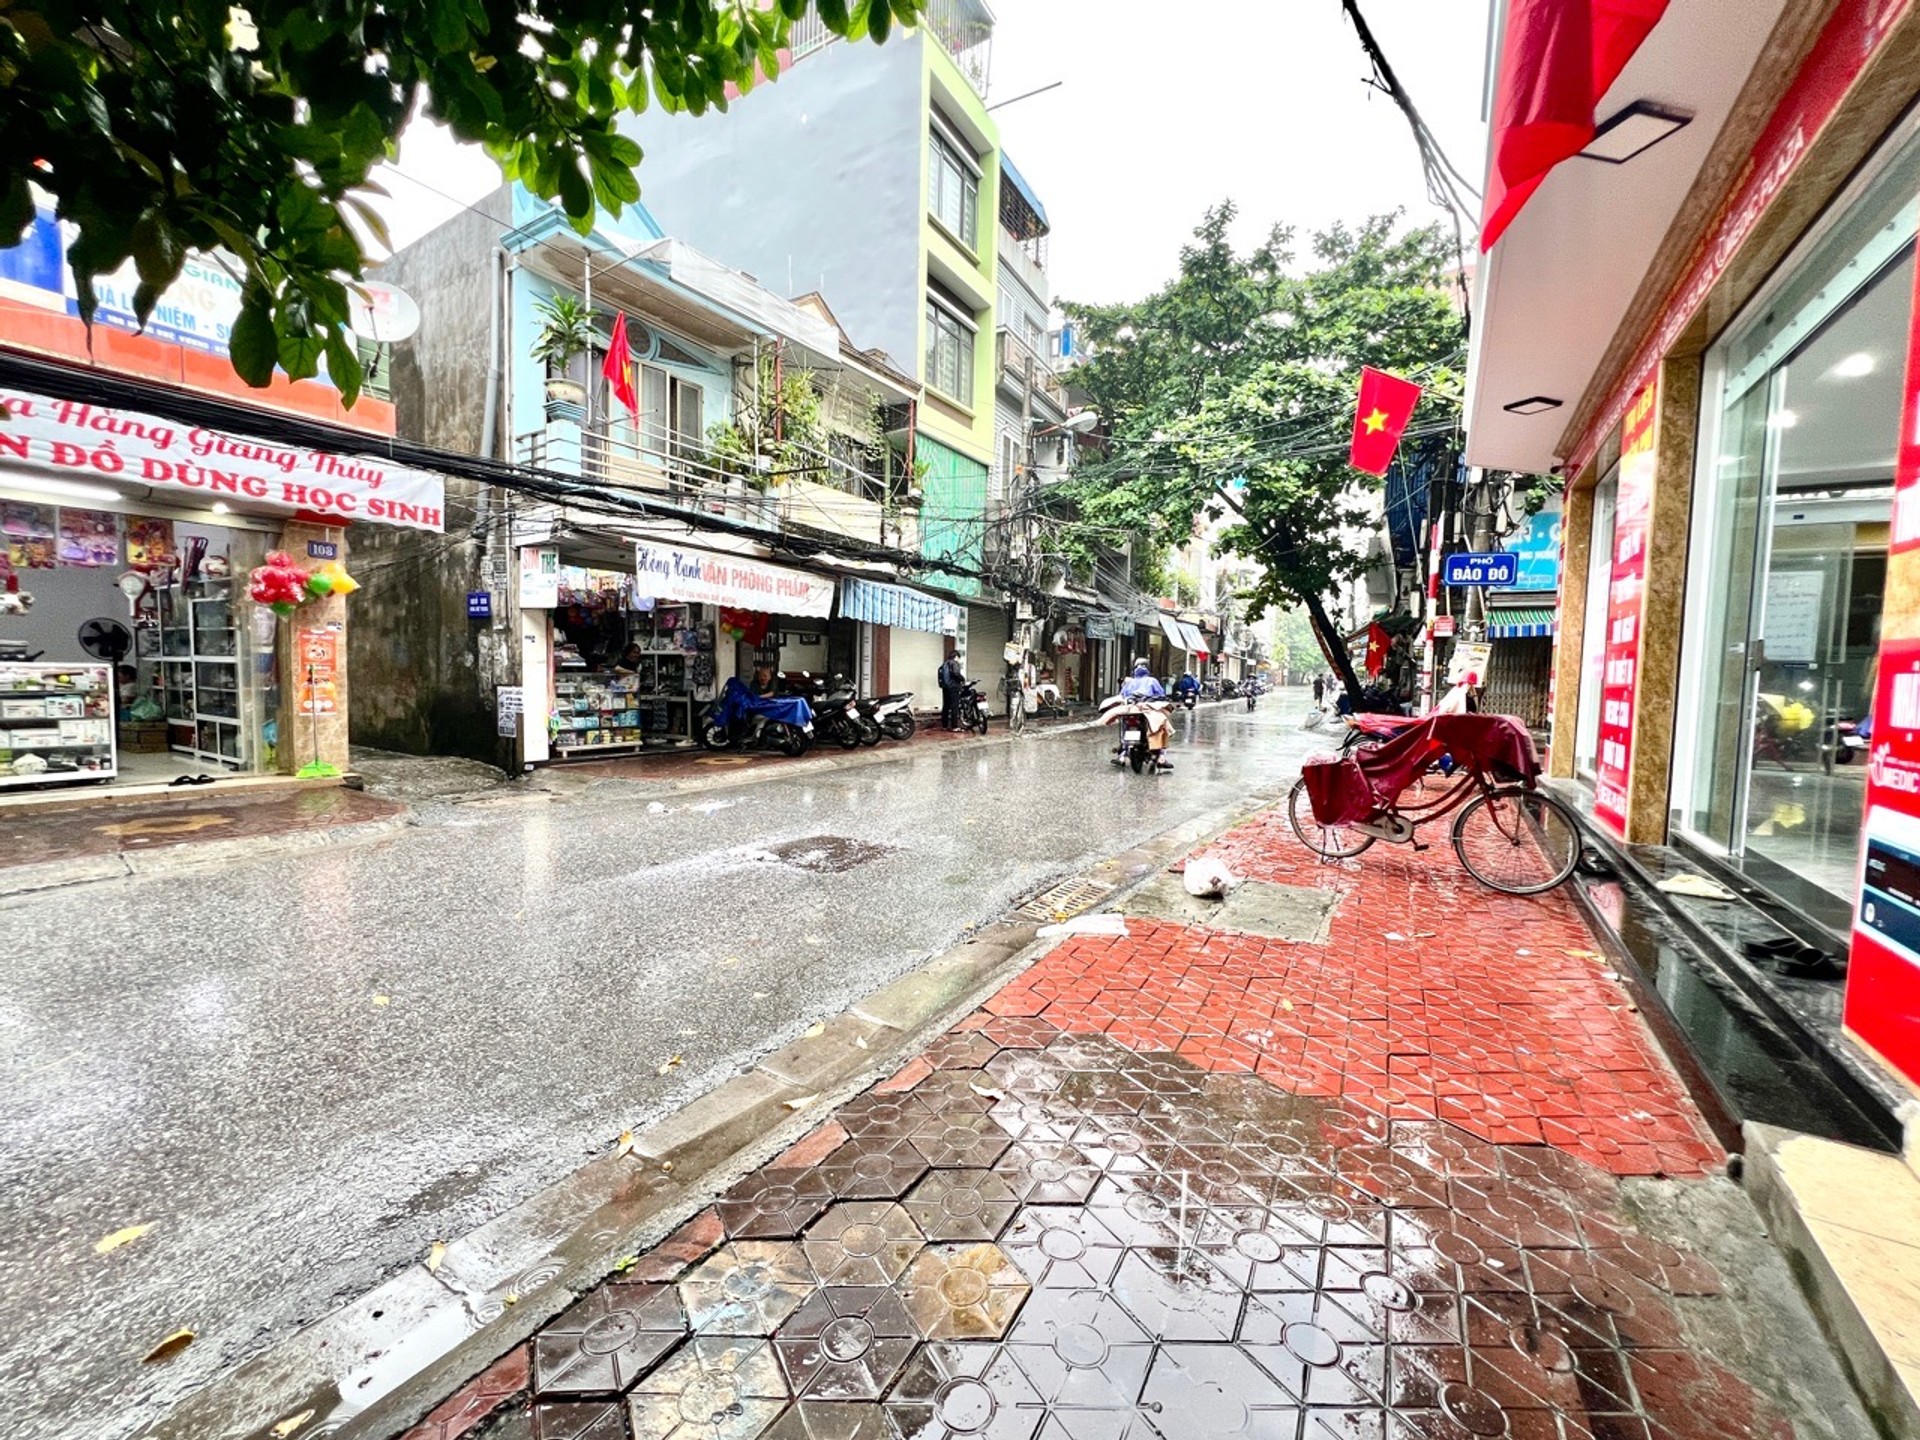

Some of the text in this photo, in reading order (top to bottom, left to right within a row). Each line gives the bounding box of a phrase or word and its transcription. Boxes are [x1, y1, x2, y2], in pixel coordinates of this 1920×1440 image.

[156, 304, 197, 332] NIỆM
[188, 427, 301, 473] Giang
[51, 440, 125, 473] ĐỒ
[140, 457, 269, 498] DÙNG
[282, 482, 357, 512] HỌC
[368, 498, 442, 526] SINH
[313, 544, 334, 556] 108
[702, 560, 728, 587] VĂN
[731, 567, 774, 594] PHÒNG
[1453, 565, 1482, 580] ĐÀO
[1488, 565, 1509, 580] ĐÔ
